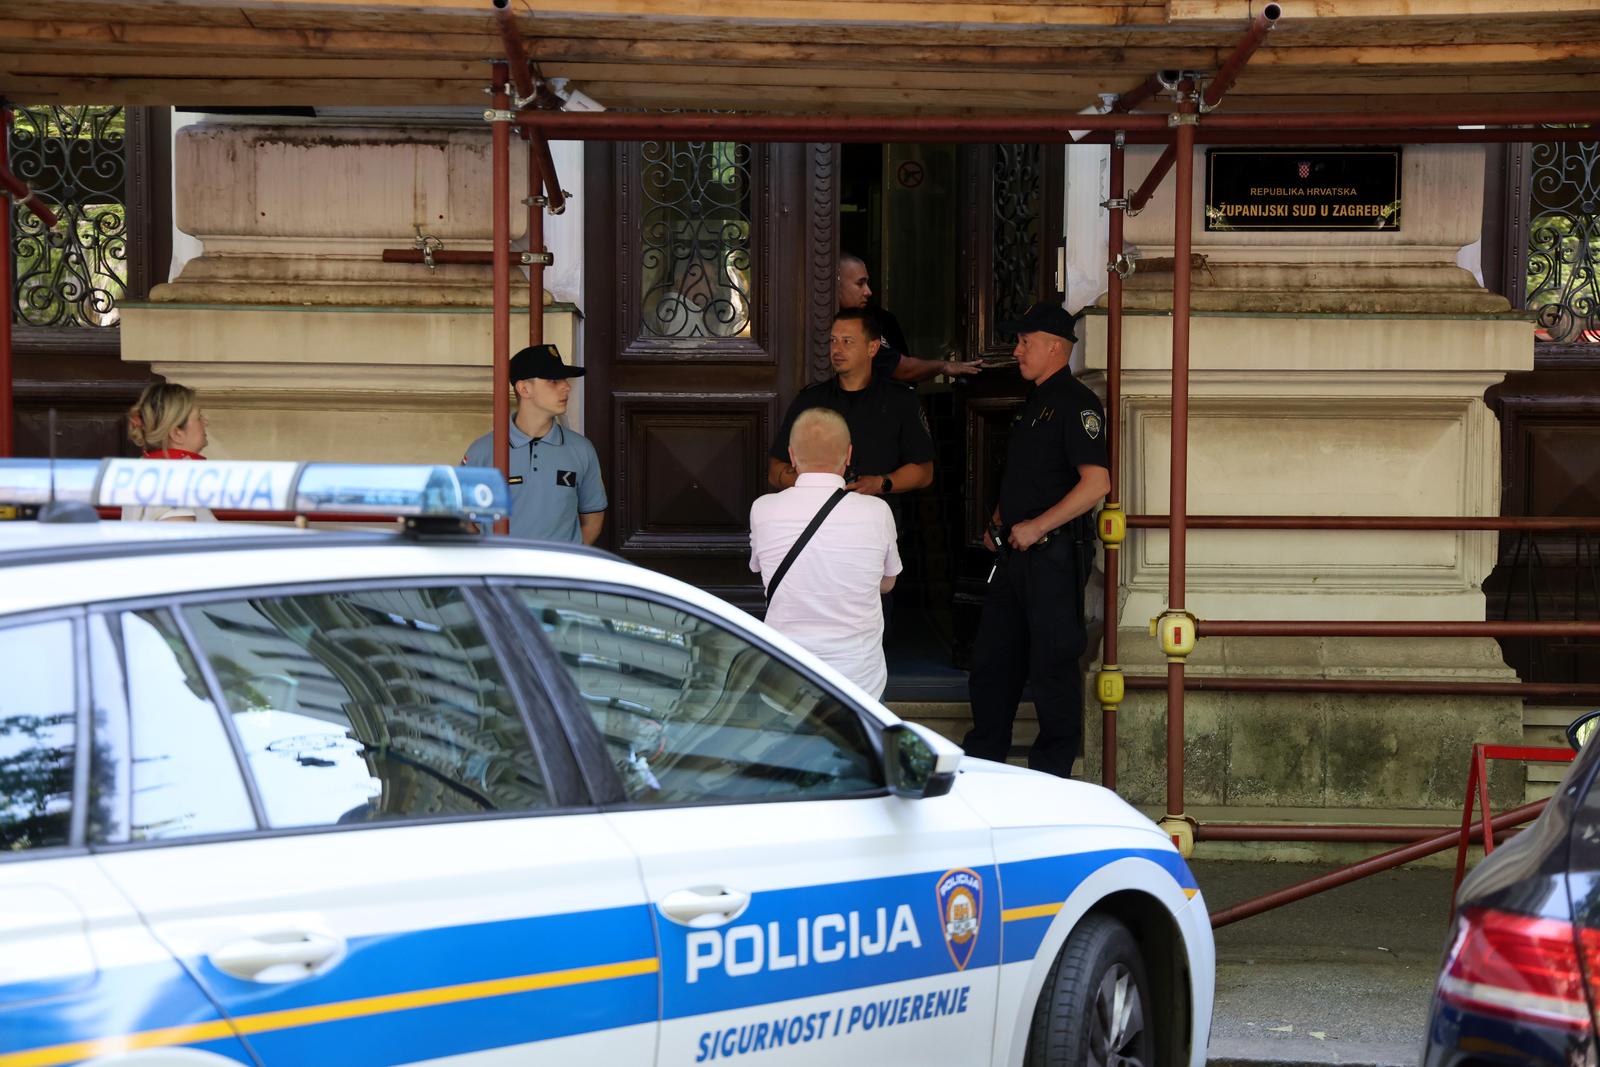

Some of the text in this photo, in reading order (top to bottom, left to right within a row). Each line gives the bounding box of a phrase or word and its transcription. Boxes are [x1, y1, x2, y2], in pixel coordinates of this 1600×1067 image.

[1219, 202, 1389, 217] ŽUPANIJSKI SUD U ZAGREBU
[1250, 187, 1357, 196] REPUBLIKA HRVATSKA
[109, 464, 275, 509] POLICIJA
[686, 903, 922, 984] POLICIJA
[696, 985, 971, 1063] SIGURNOST I POVJERENJE
